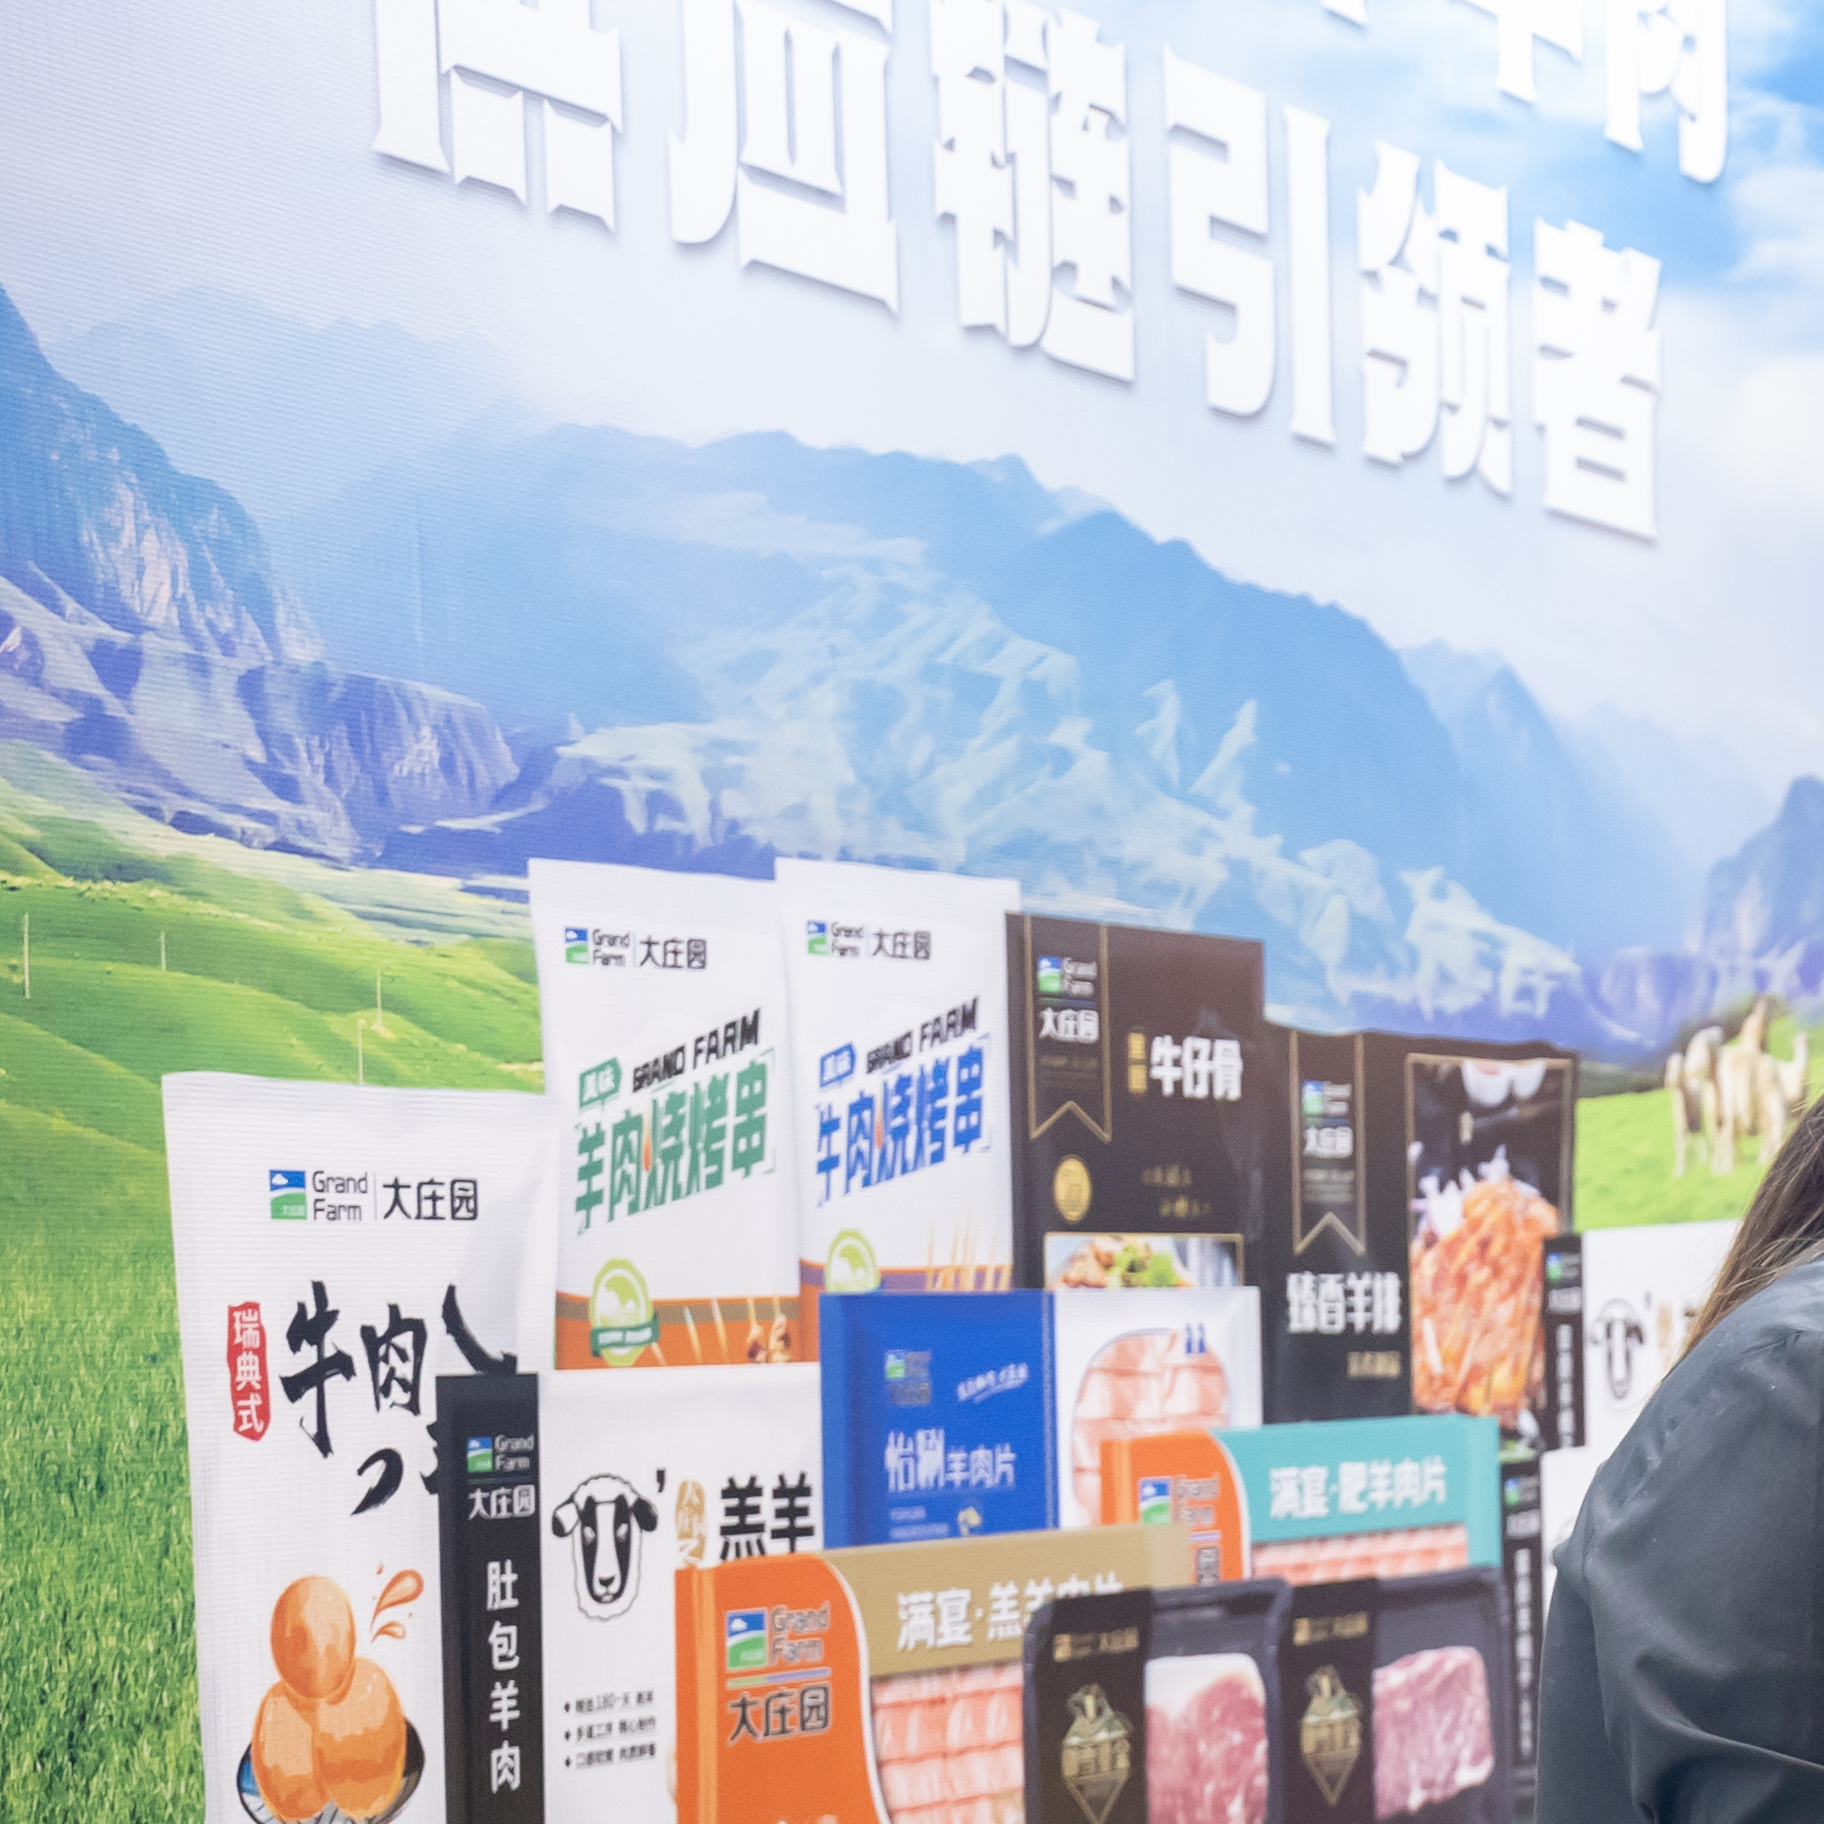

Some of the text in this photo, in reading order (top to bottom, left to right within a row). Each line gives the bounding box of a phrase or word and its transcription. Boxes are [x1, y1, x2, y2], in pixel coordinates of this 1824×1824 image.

[639, 932, 708, 970] 大庄园
[872, 929, 932, 961] 大庄园
[920, 994, 980, 1052] FARM
[1039, 1007, 1100, 1045] 大庄园
[632, 1006, 762, 1094] GRAND FARM
[1149, 1033, 1244, 1100] 牛仔骨
[815, 1044, 984, 1202] 牛肉烧烤串
[575, 1058, 768, 1236] 羊肉烧烤串
[312, 1171, 368, 1195] Grand
[382, 1178, 479, 1222] 大庄园
[313, 1199, 363, 1222] Farm
[232, 1308, 266, 1436] 瑞典式
[494, 1434, 535, 1453] Grand
[494, 1452, 531, 1472] Farm
[467, 1484, 536, 1522] 大庄园
[770, 1602, 831, 1635] Grand
[770, 1632, 824, 1665] Farm
[485, 1558, 521, 1795] 肚包羊肉
[726, 1682, 831, 1746] 大庄园
